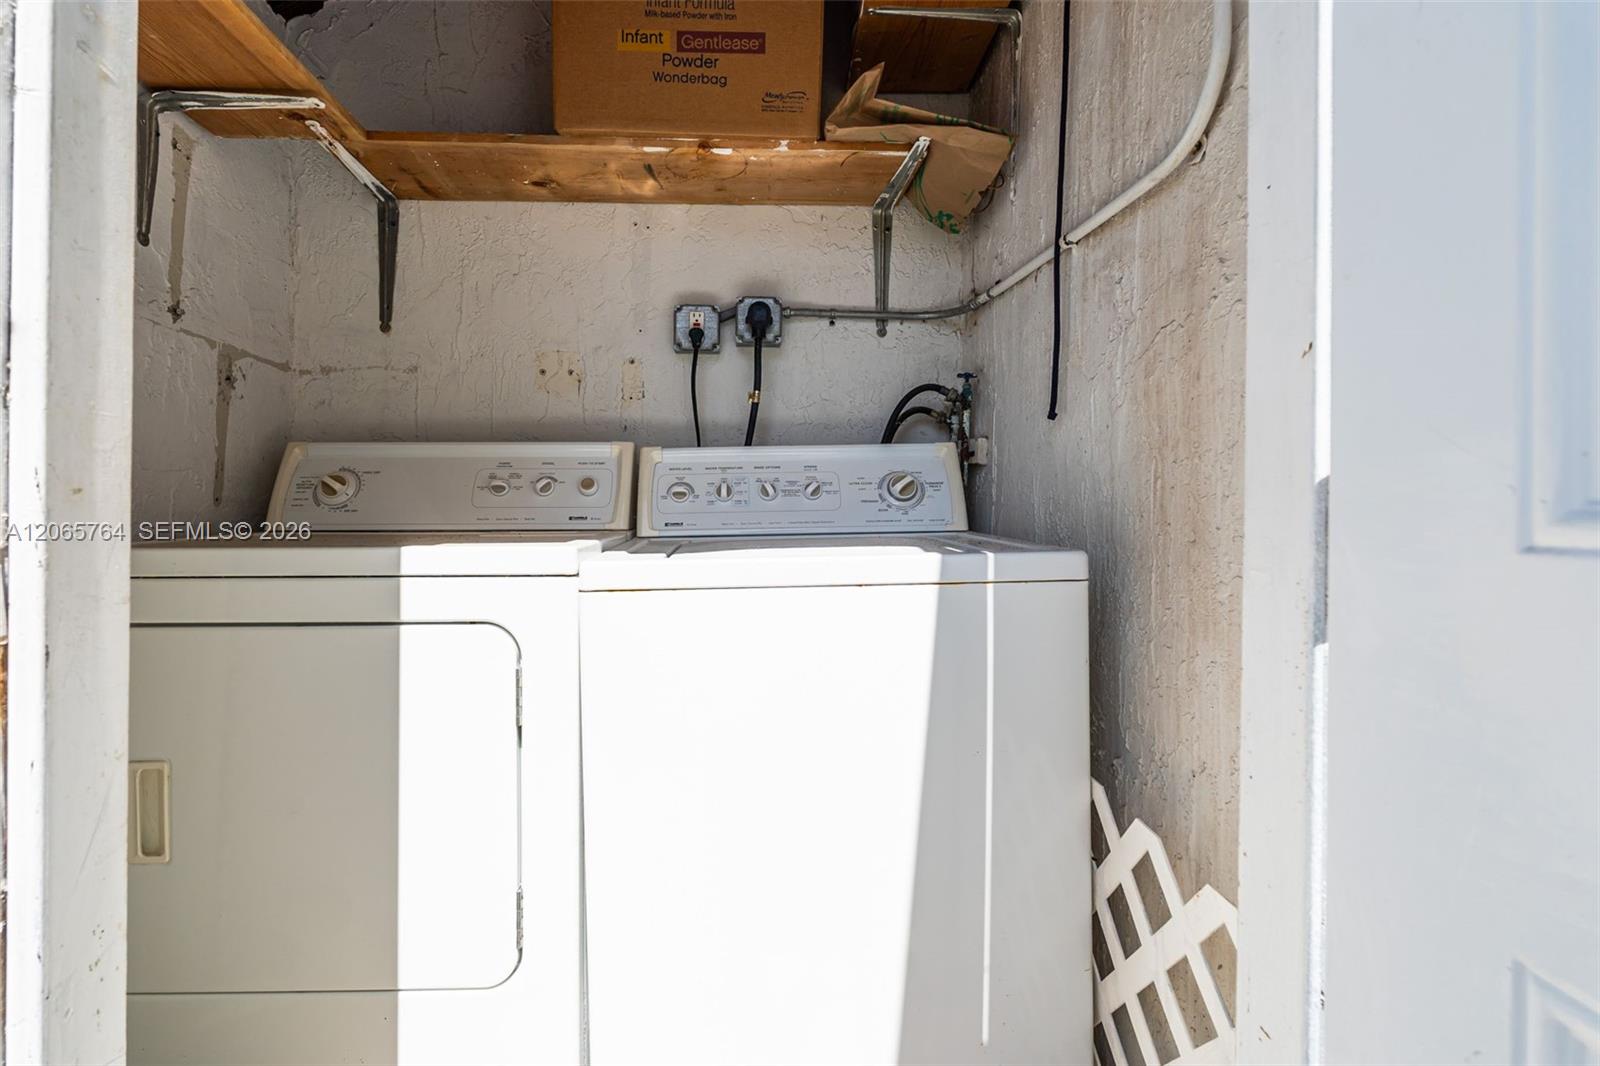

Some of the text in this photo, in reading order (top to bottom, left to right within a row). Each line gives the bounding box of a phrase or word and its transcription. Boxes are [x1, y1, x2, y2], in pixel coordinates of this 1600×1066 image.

[682, 10, 707, 20] Powder
[708, 12, 723, 20] with
[724, 13, 737, 21] Iron
[620, 29, 664, 44] Infant
[662, 53, 719, 69] Powder
[652, 71, 728, 88] Wonderbag
